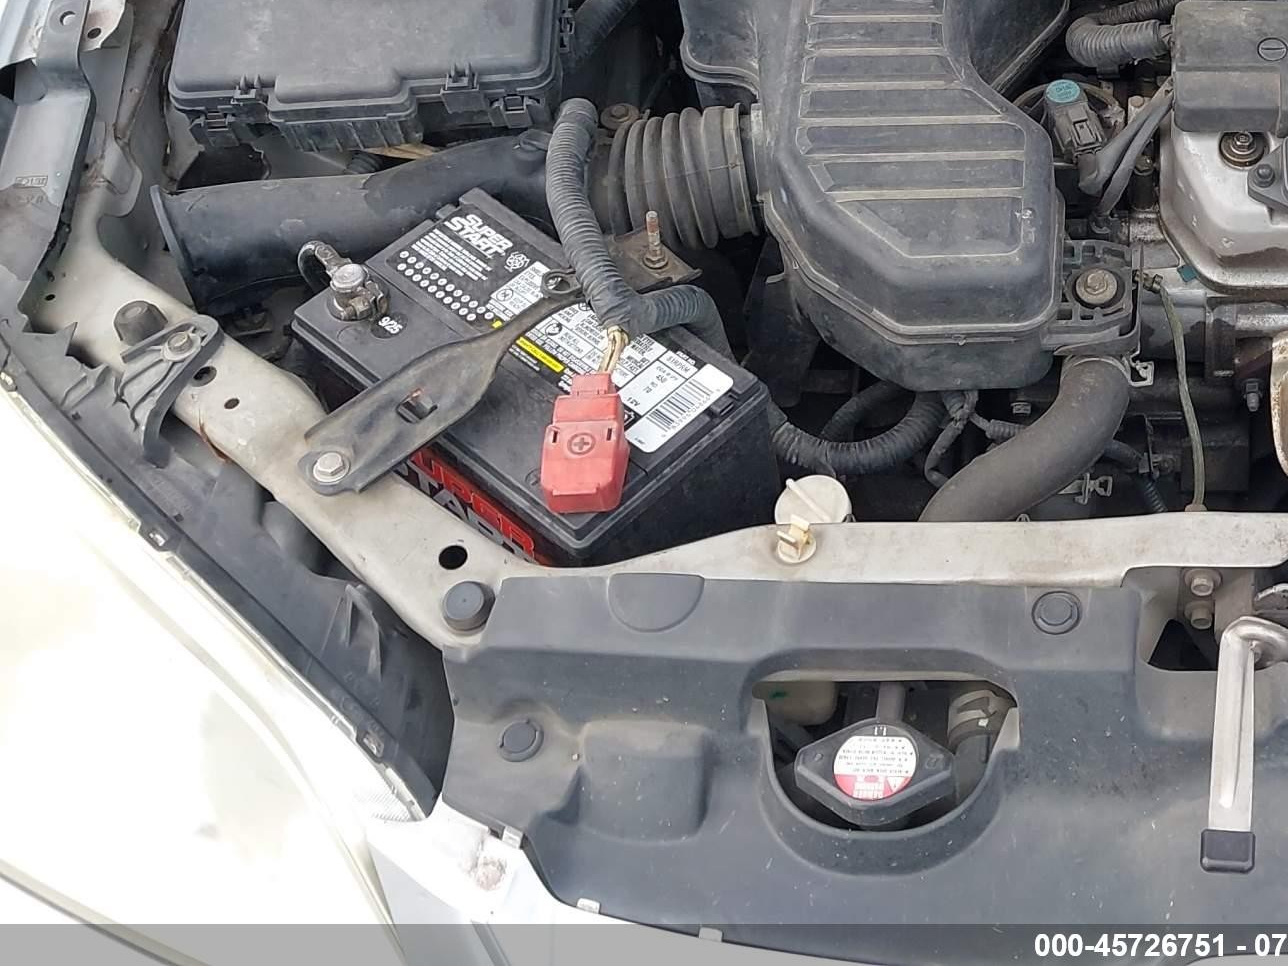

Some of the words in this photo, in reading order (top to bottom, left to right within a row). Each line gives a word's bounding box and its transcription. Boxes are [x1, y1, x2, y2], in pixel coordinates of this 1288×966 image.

[444, 216, 500, 259] START
[466, 214, 513, 248] SUPER
[378, 316, 403, 334] 9/25
